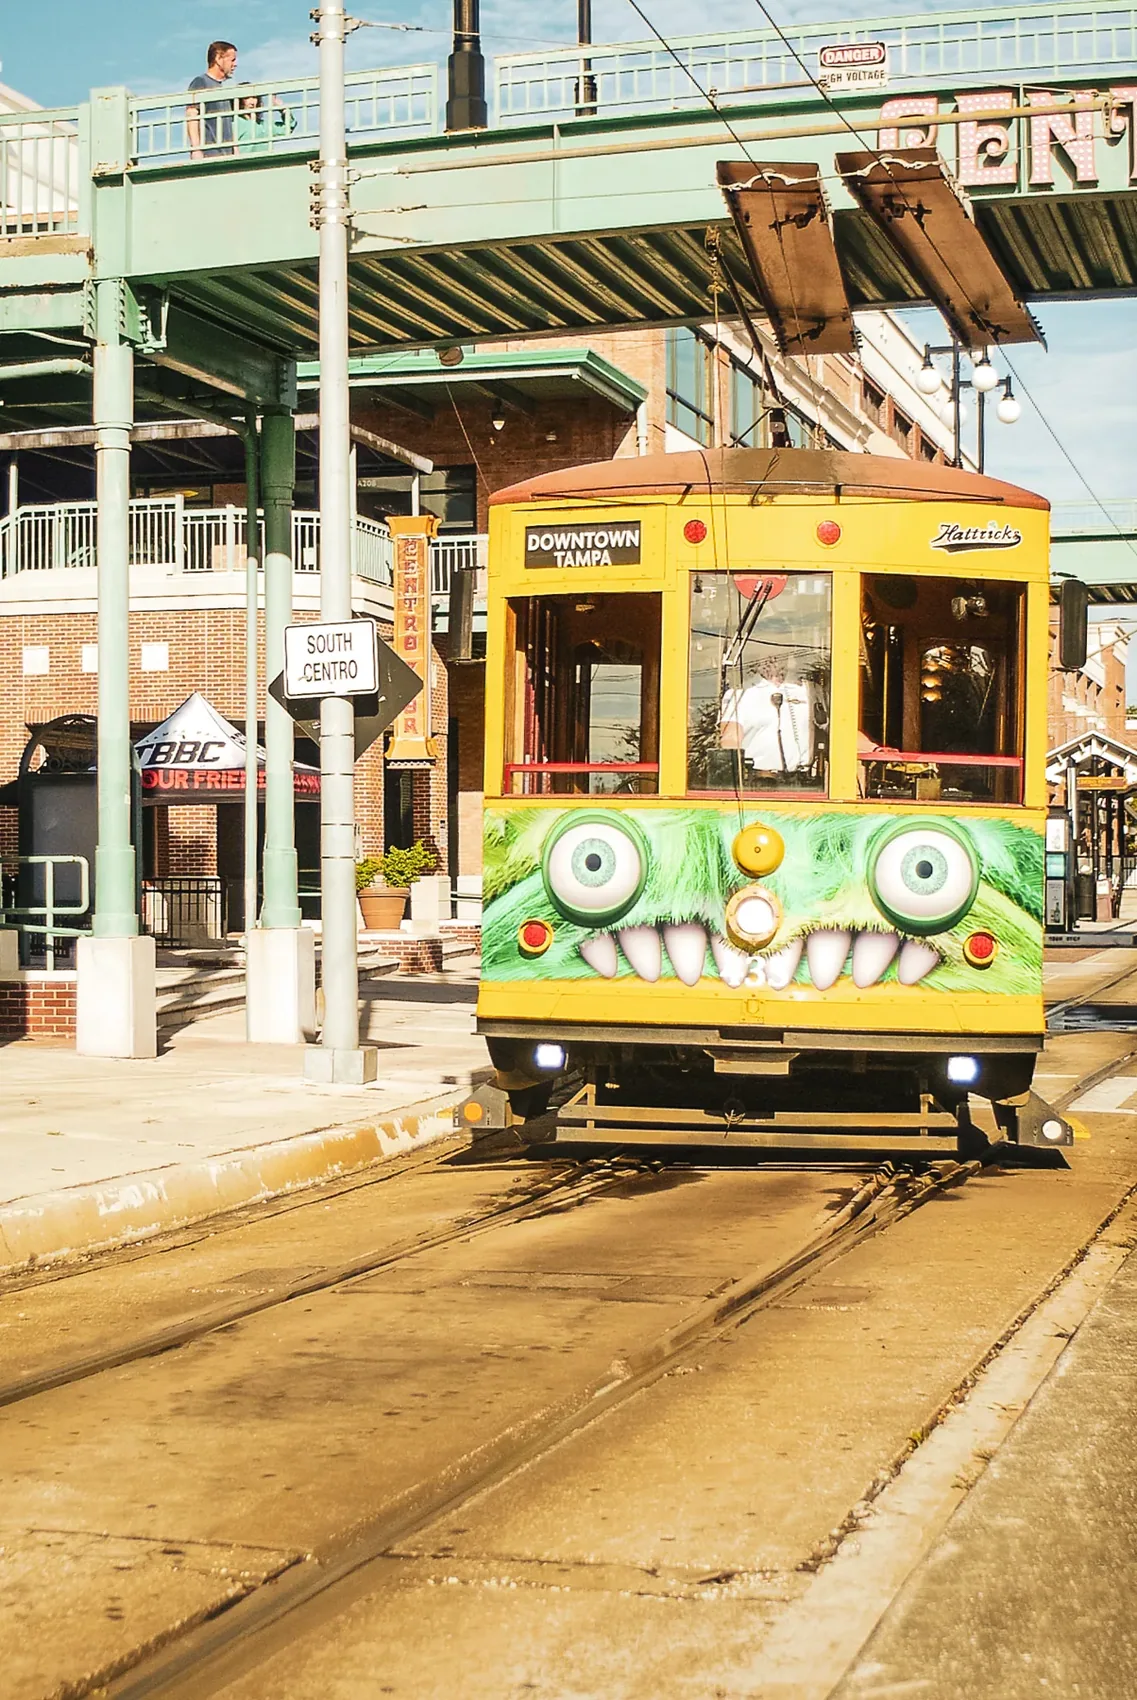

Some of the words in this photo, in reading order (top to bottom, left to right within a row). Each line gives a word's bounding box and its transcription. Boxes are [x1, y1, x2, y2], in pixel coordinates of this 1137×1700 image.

[825, 48, 880, 64] DANGER
[846, 69, 886, 82] VOLTAGE
[527, 529, 640, 551] DOWNTOWN
[931, 523, 1021, 542] Hattricks
[553, 549, 613, 568] TAMPA
[307, 632, 353, 654] SOUTH
[303, 659, 358, 682] CENTRO
[404, 661, 418, 735] OR
